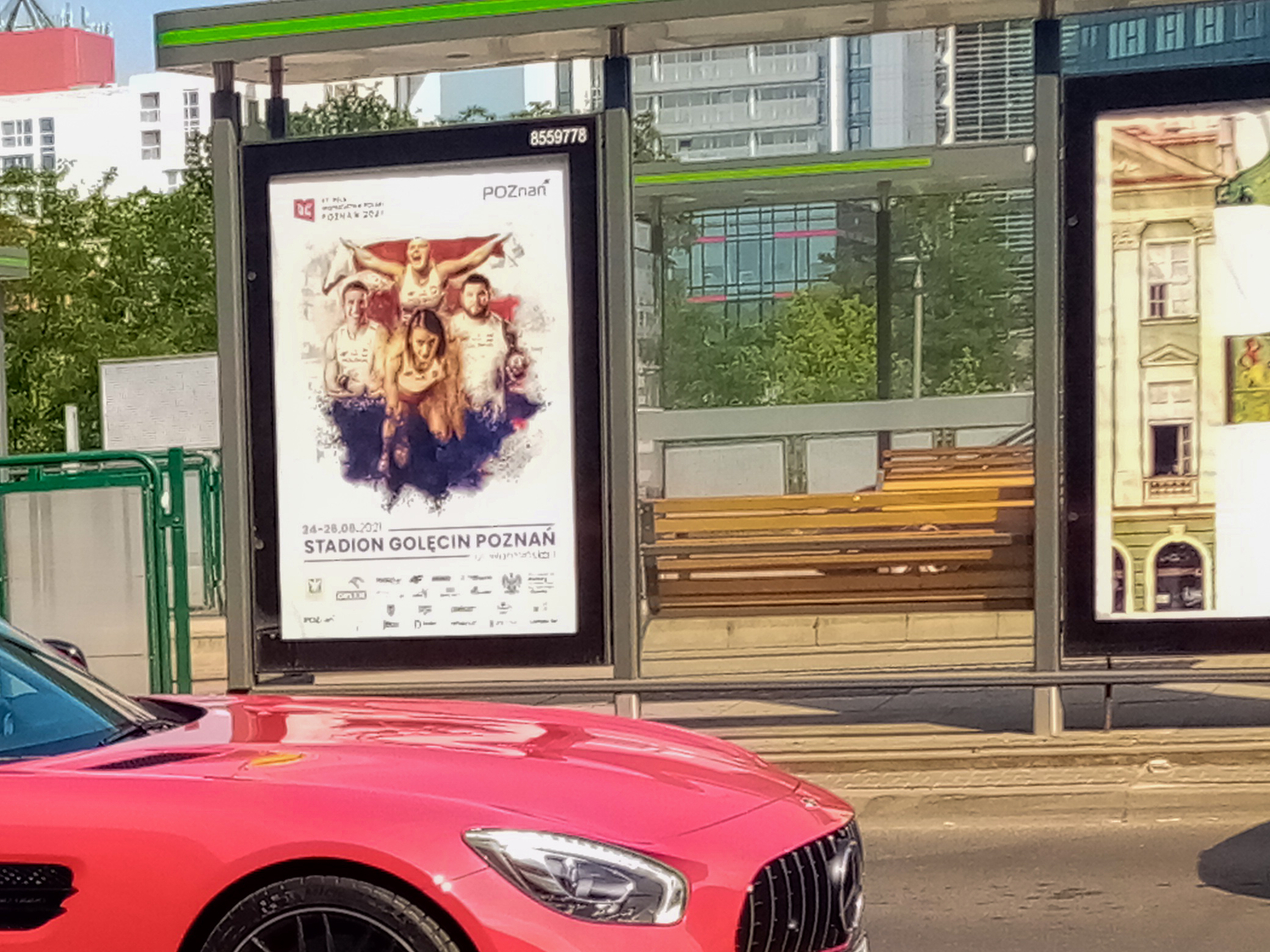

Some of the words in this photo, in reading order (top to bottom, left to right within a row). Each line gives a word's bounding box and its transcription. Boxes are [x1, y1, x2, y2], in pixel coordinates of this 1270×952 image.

[530, 127, 587, 146] 8559778
[304, 538, 384, 554] STADION
[389, 534, 471, 553] GOLĘCIN
[475, 526, 556, 548] POZNAŃ
